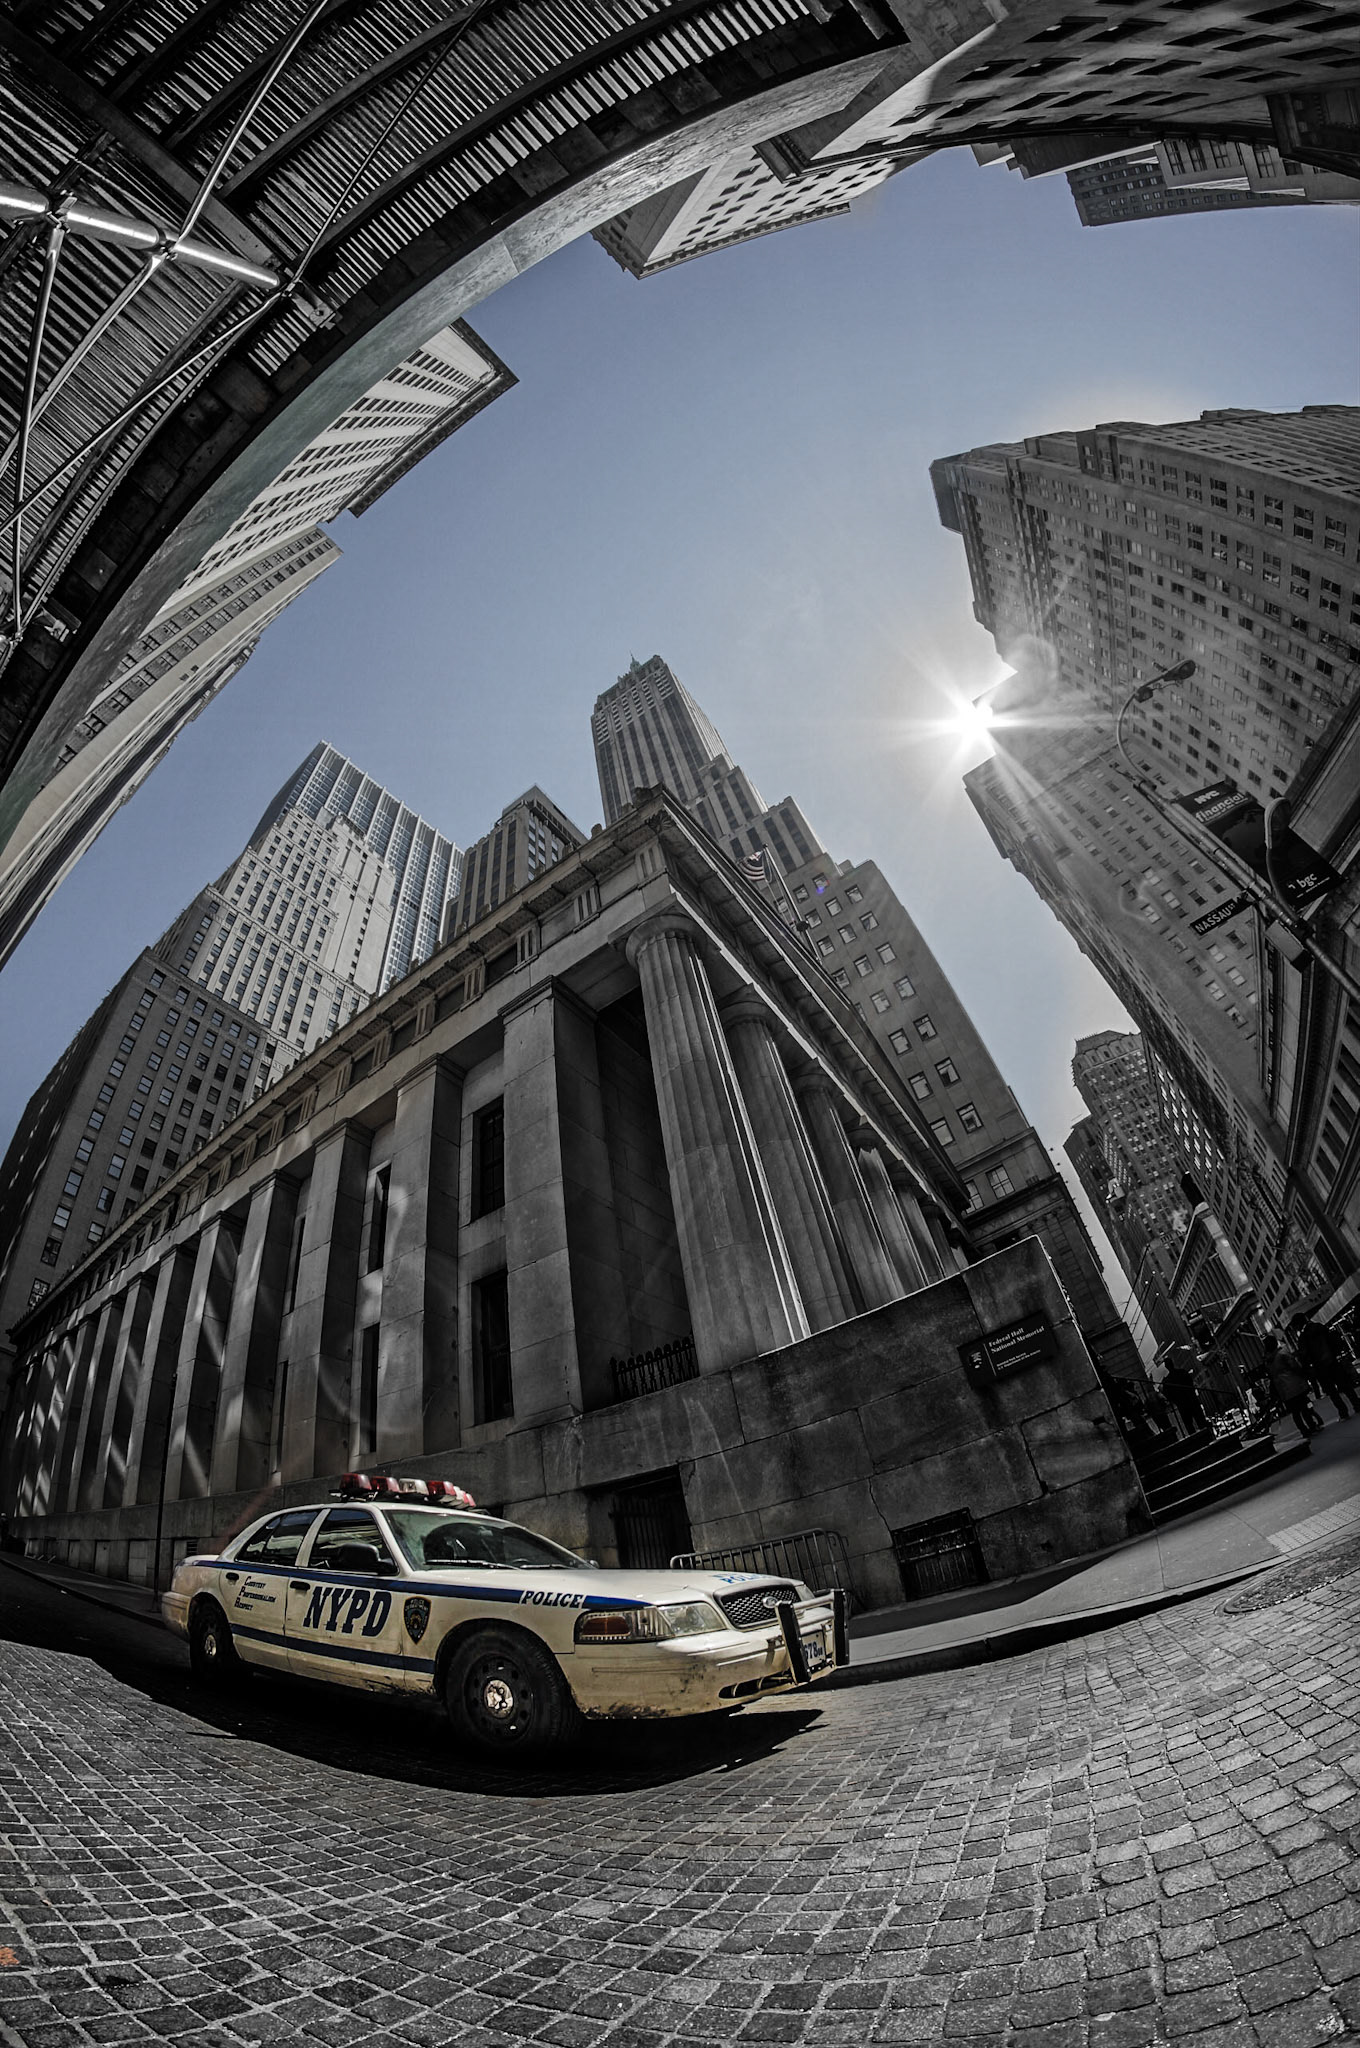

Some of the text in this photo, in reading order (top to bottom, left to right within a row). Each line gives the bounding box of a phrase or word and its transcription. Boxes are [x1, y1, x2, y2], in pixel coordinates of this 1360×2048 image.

[1194, 790, 1220, 804] NYC
[1195, 793, 1244, 822] financial
[1296, 873, 1318, 888] bgc
[1194, 907, 1232, 933] NASSAU
[988, 1327, 1025, 1347] Federal Hall
[990, 1325, 1045, 1354] National Memorial
[521, 1590, 583, 1608] POLICE
[303, 1586, 392, 1637] NYPD
